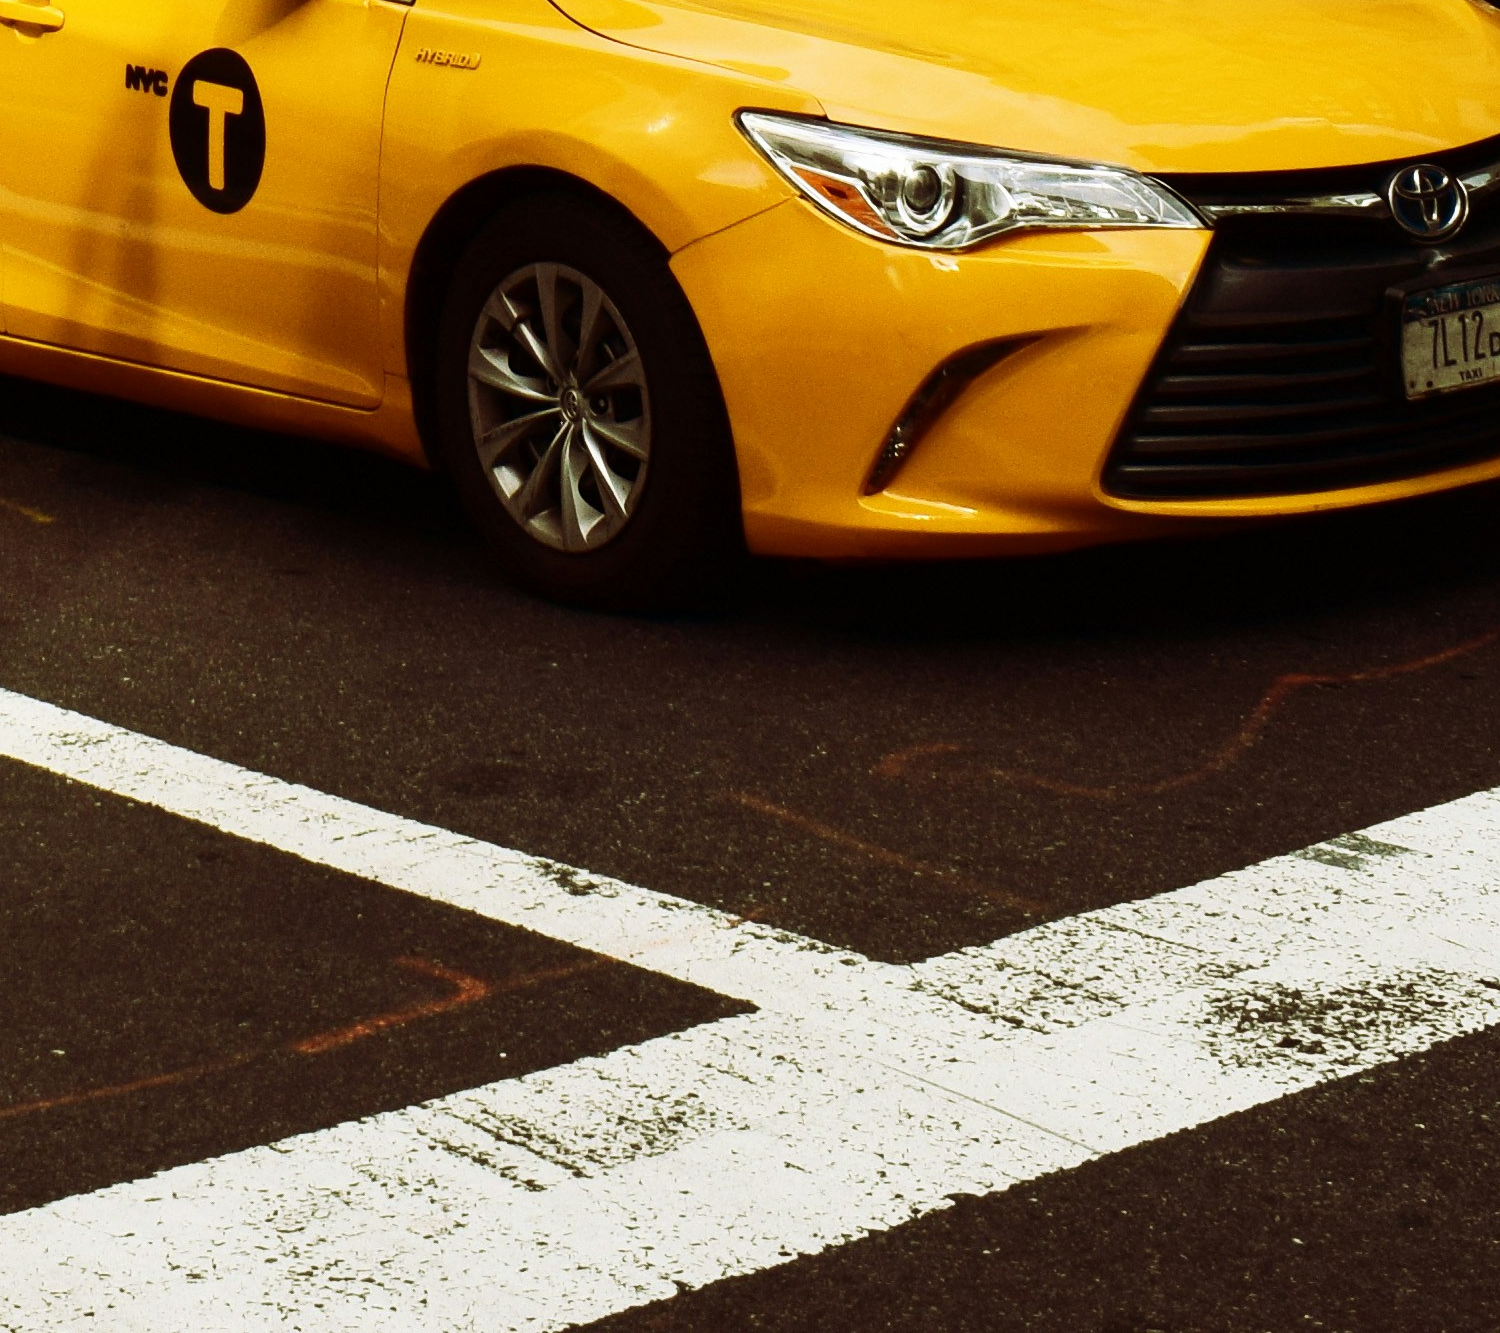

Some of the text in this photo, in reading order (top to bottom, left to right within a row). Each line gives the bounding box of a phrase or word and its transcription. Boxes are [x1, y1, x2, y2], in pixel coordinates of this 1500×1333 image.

[125, 64, 168, 97] NYC
[192, 79, 245, 190] T
[1459, 367, 1483, 381] TAXI
